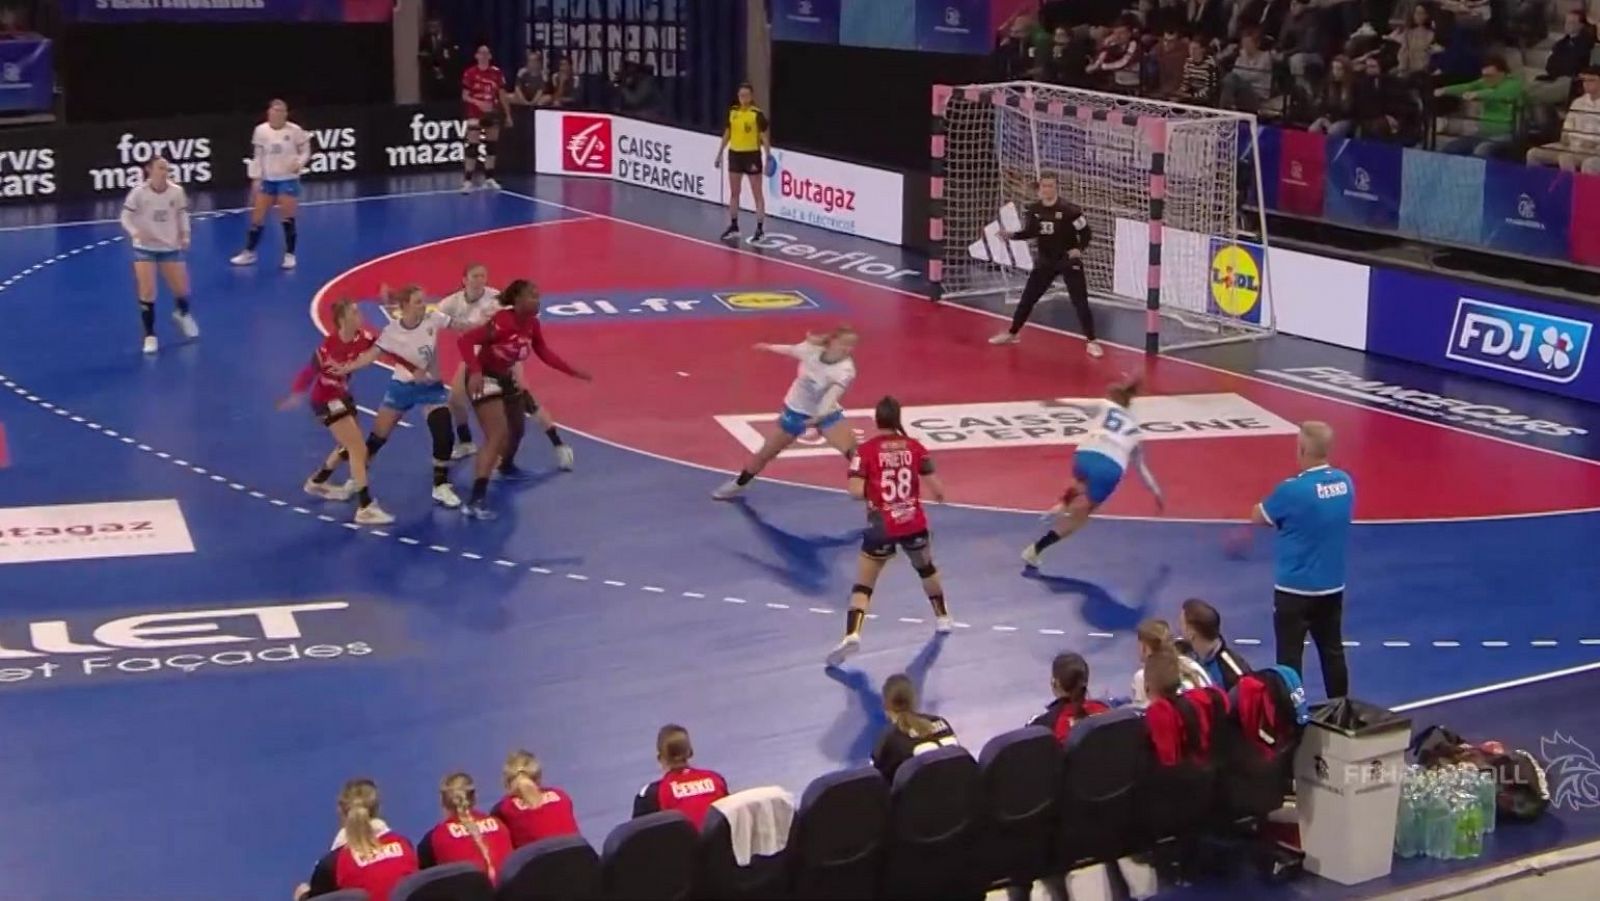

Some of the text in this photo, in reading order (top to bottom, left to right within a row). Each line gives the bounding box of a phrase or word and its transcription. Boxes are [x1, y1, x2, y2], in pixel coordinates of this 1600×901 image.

[311, 127, 356, 149] vis
[410, 113, 487, 141] forv
[117, 133, 211, 164] forvis
[386, 142, 487, 167] mazas
[617, 134, 673, 164] CAISSE
[0, 172, 57, 198] ars
[89, 160, 212, 191] maars
[618, 158, 706, 195] D'EPARGNE
[780, 169, 856, 213] Butagaz
[746, 232, 922, 280] Gerflor
[545, 297, 701, 316] dl.fr
[1458, 312, 1536, 361] FDJ
[910, 410, 1088, 432] CAISS
[925, 416, 1271, 444] D'EPAGNE
[878, 451, 913, 468] PRIETO
[880, 468, 912, 502] 58
[0, 521, 154, 538] tagaz
[83, 640, 373, 676] Façades
[447, 818, 499, 838] ČEKO
